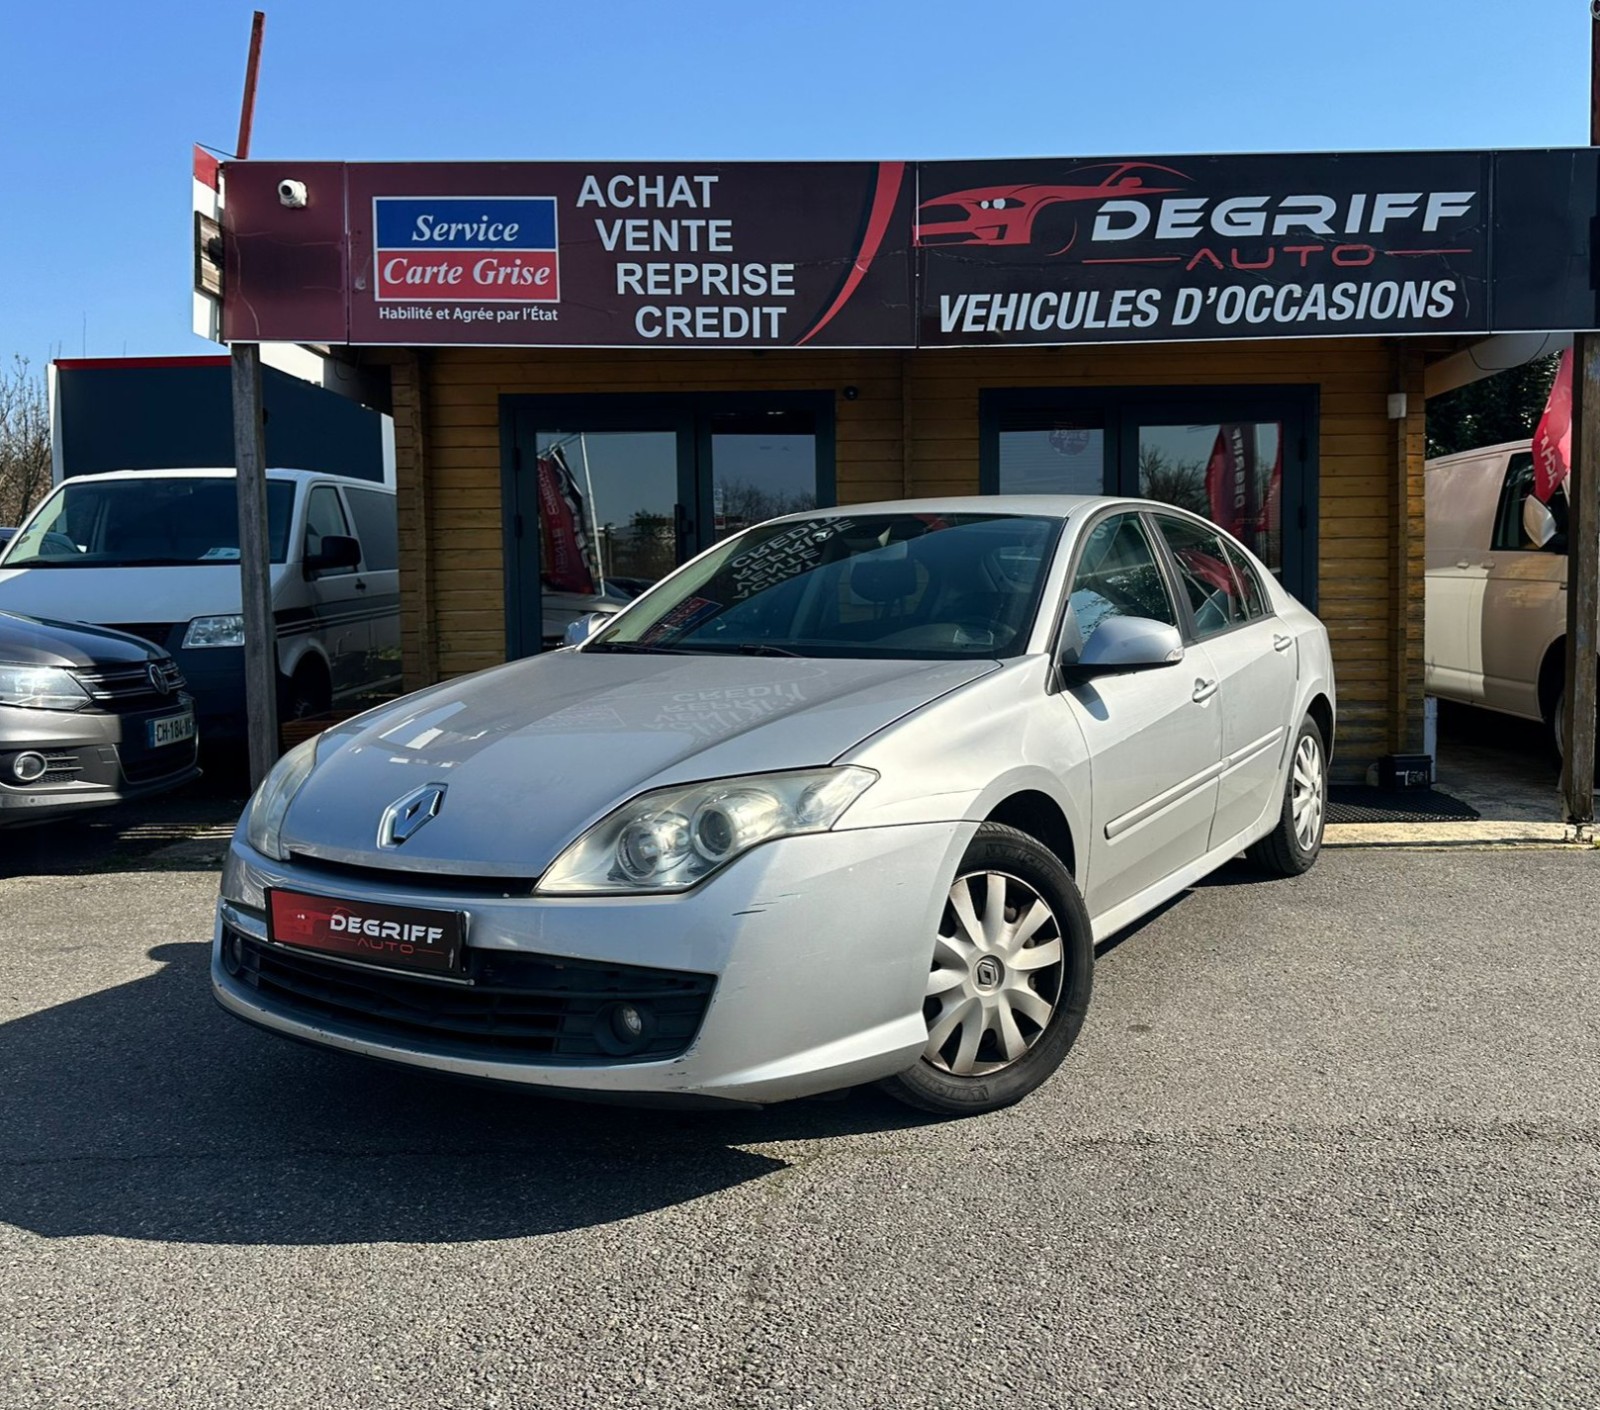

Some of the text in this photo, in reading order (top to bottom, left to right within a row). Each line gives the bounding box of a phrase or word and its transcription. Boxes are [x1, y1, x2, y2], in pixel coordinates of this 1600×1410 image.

[576, 175, 719, 208] ACHAT
[411, 214, 519, 242] Service
[1091, 191, 1477, 242] DEGRIFF
[594, 218, 733, 252] VENTE
[383, 258, 551, 285] Carte Grise
[1185, 243, 1376, 271] AUTO
[616, 263, 795, 296] REPRISE
[379, 306, 432, 321] Habilité
[435, 308, 450, 321] et
[453, 307, 494, 323] Agrée
[497, 310, 520, 323] par
[635, 306, 787, 339] CREDIT
[939, 288, 1161, 334] VEHICULES
[329, 913, 444, 945] DEGRIFF
[357, 938, 415, 954] AUTO
